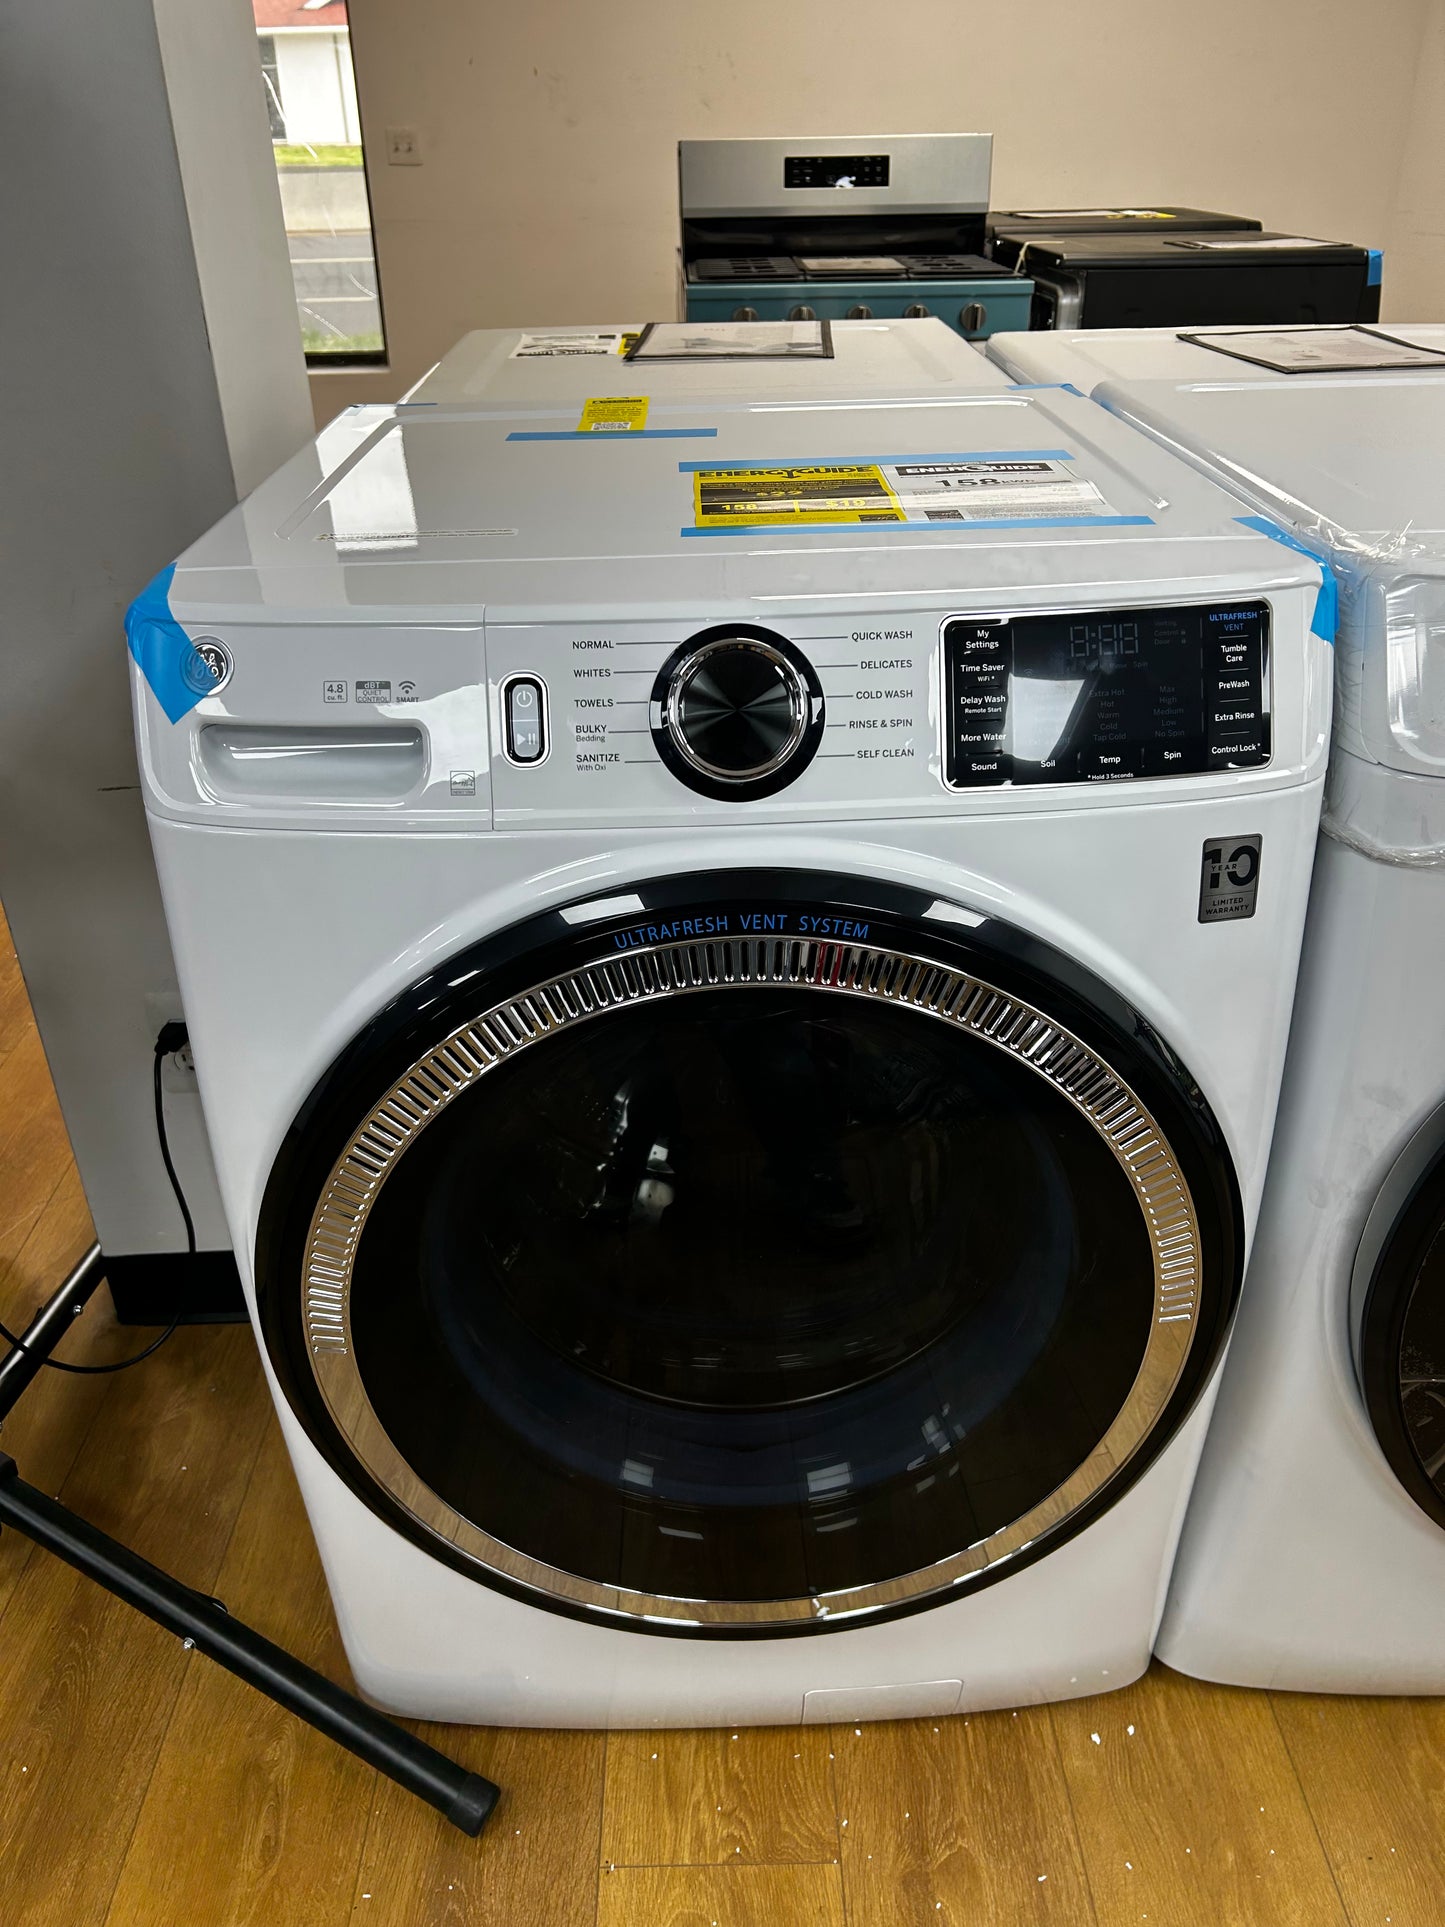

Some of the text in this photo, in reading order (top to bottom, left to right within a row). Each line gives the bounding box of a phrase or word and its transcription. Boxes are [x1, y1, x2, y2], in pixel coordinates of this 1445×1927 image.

[936, 478, 999, 487] 158
[1209, 611, 1258, 622] ULTRAFRESH
[1223, 622, 1244, 631] VENT
[851, 630, 913, 641] QUICK WASH
[976, 629, 989, 640] My
[572, 640, 614, 649] NORMAL
[965, 639, 999, 650] Settings
[1221, 644, 1247, 653] Tumble
[1226, 653, 1243, 663] Care
[860, 660, 913, 669] DELICATES
[960, 663, 1005, 672] Time Saver
[573, 669, 611, 678] WHITES
[327, 683, 344, 693] 4.8
[1218, 679, 1250, 689] PreWash
[856, 689, 913, 699] COLD WASH
[574, 698, 614, 708] TOWELS
[960, 694, 1006, 706] Delay Wash
[1097, 711, 1120, 719] Warm
[1153, 708, 1184, 716] Medium
[1214, 710, 1255, 722] Extra Rinse
[849, 719, 913, 729] RINSE & SPIN
[1100, 722, 1118, 730] Cold
[575, 725, 607, 734] BULKY
[576, 734, 606, 743] Bedding
[961, 732, 1007, 742] More Water
[1094, 732, 1127, 742] Tap Cold
[857, 748, 915, 759] SELF CLEAN
[1164, 750, 1182, 760] Spin
[1211, 745, 1240, 755] Control
[576, 753, 620, 763] SANITIZE
[1099, 755, 1121, 765] Temp
[971, 762, 997, 771] Sound
[1040, 759, 1056, 768] Soil
[1203, 844, 1259, 889] 10
[1211, 863, 1237, 872] YEAR
[1212, 897, 1244, 907] LIMITED
[1205, 904, 1249, 915] WARRANTY
[614, 914, 870, 949] ULTRAFRESH VENT SYSTEM
